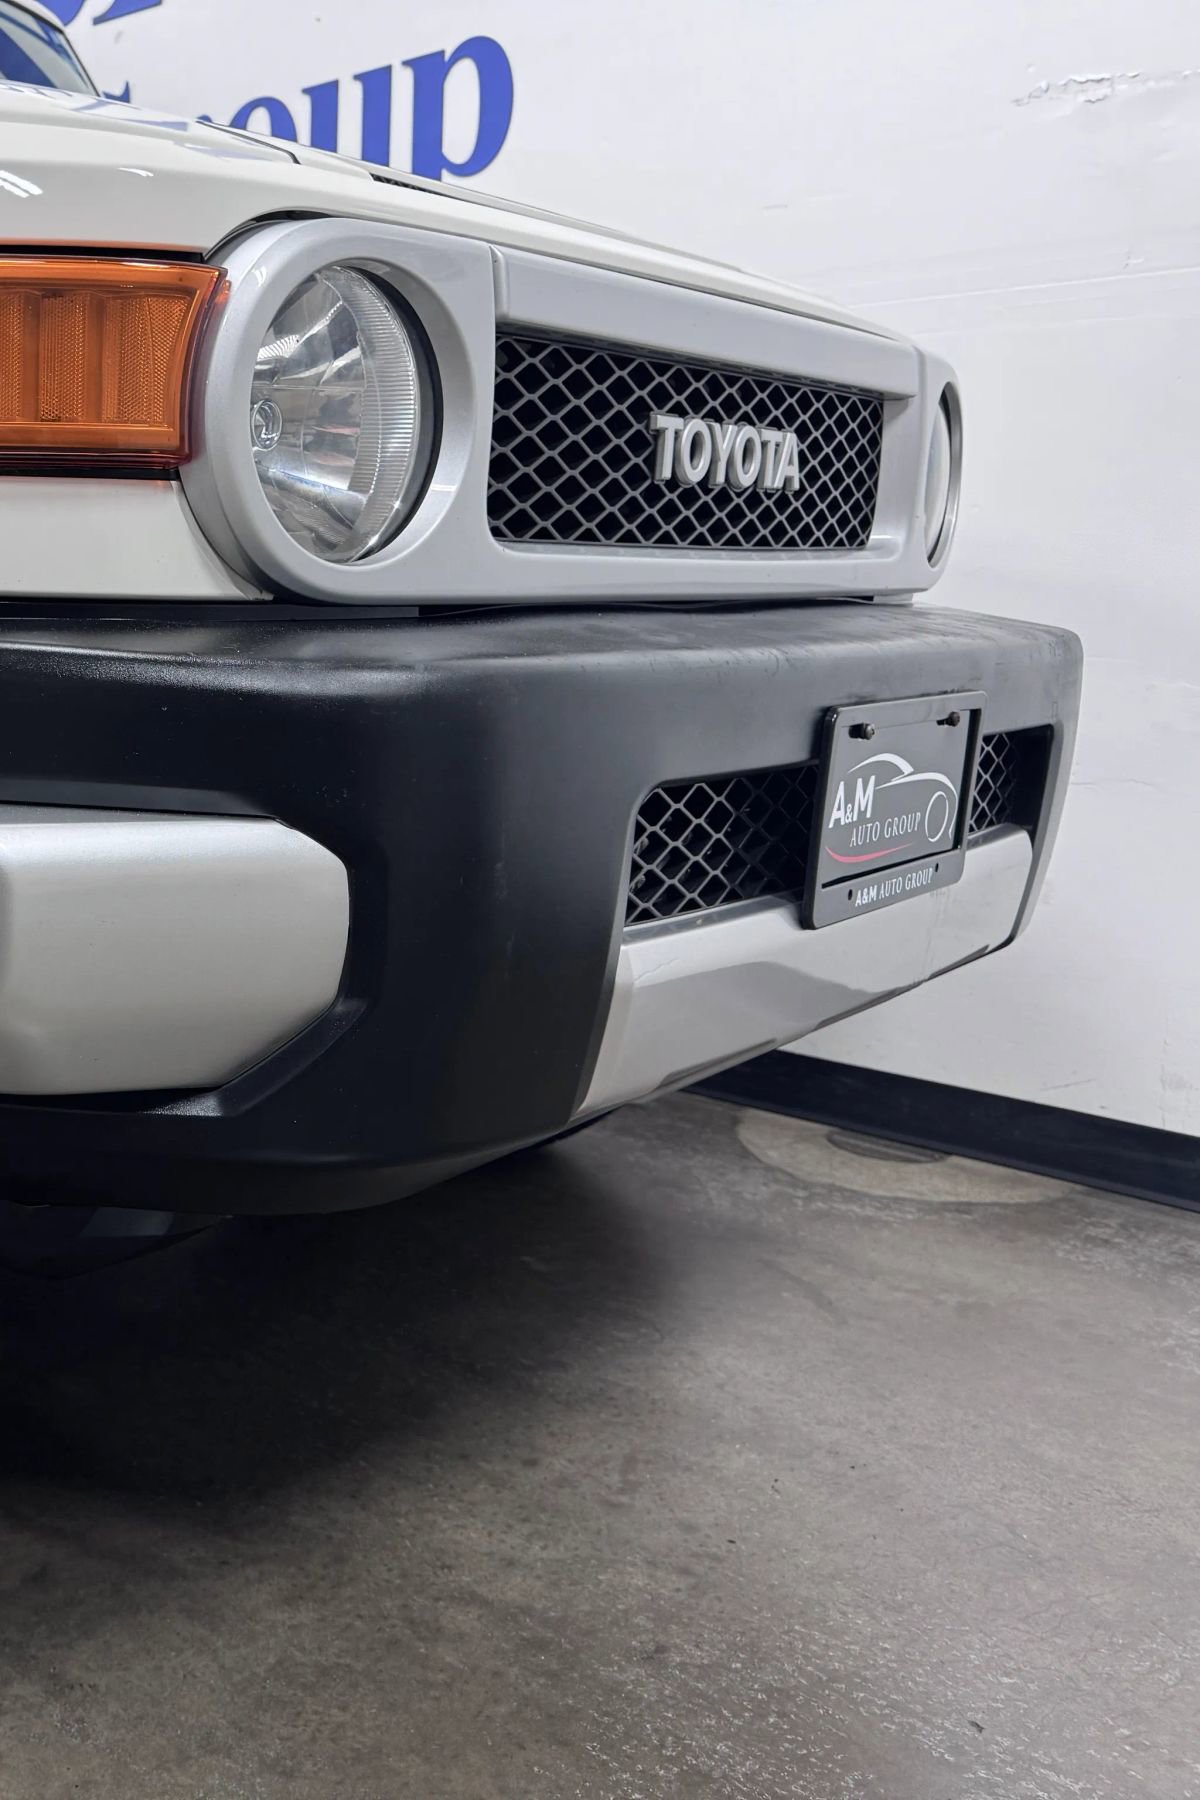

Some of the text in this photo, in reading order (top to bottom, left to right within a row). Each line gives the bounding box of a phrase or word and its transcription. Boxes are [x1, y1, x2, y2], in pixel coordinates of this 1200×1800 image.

[650, 412, 800, 494] TOYOTA
[828, 775, 876, 829] A&M
[850, 812, 921, 847] AUTO GROUP
[855, 867, 933, 907] A&M AUTO GROUP
